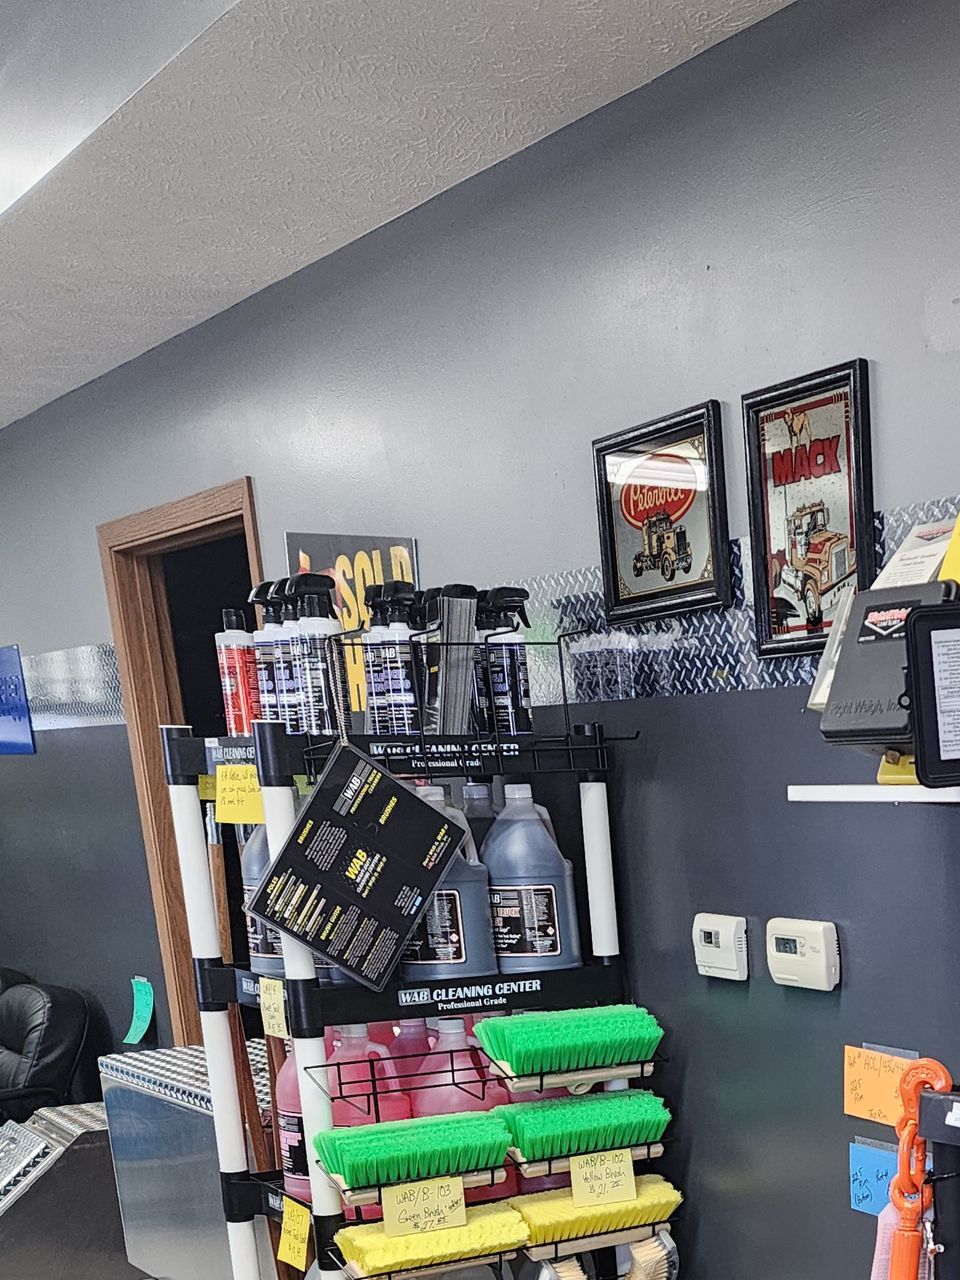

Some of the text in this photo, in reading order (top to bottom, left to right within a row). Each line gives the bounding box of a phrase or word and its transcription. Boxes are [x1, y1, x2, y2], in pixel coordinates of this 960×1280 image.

[772, 435, 841, 487] MACK
[411, 759, 458, 768] Proessional
[343, 776, 362, 800] WAB
[378, 796, 398, 825] BRUSHES
[345, 849, 367, 880] WAB
[401, 979, 541, 1004] WAB CLEANING CENTER
[438, 996, 507, 1011] Professional Grade
[605, 1167, 626, 1179] Brush
[398, 1204, 446, 1224] Green Brush
